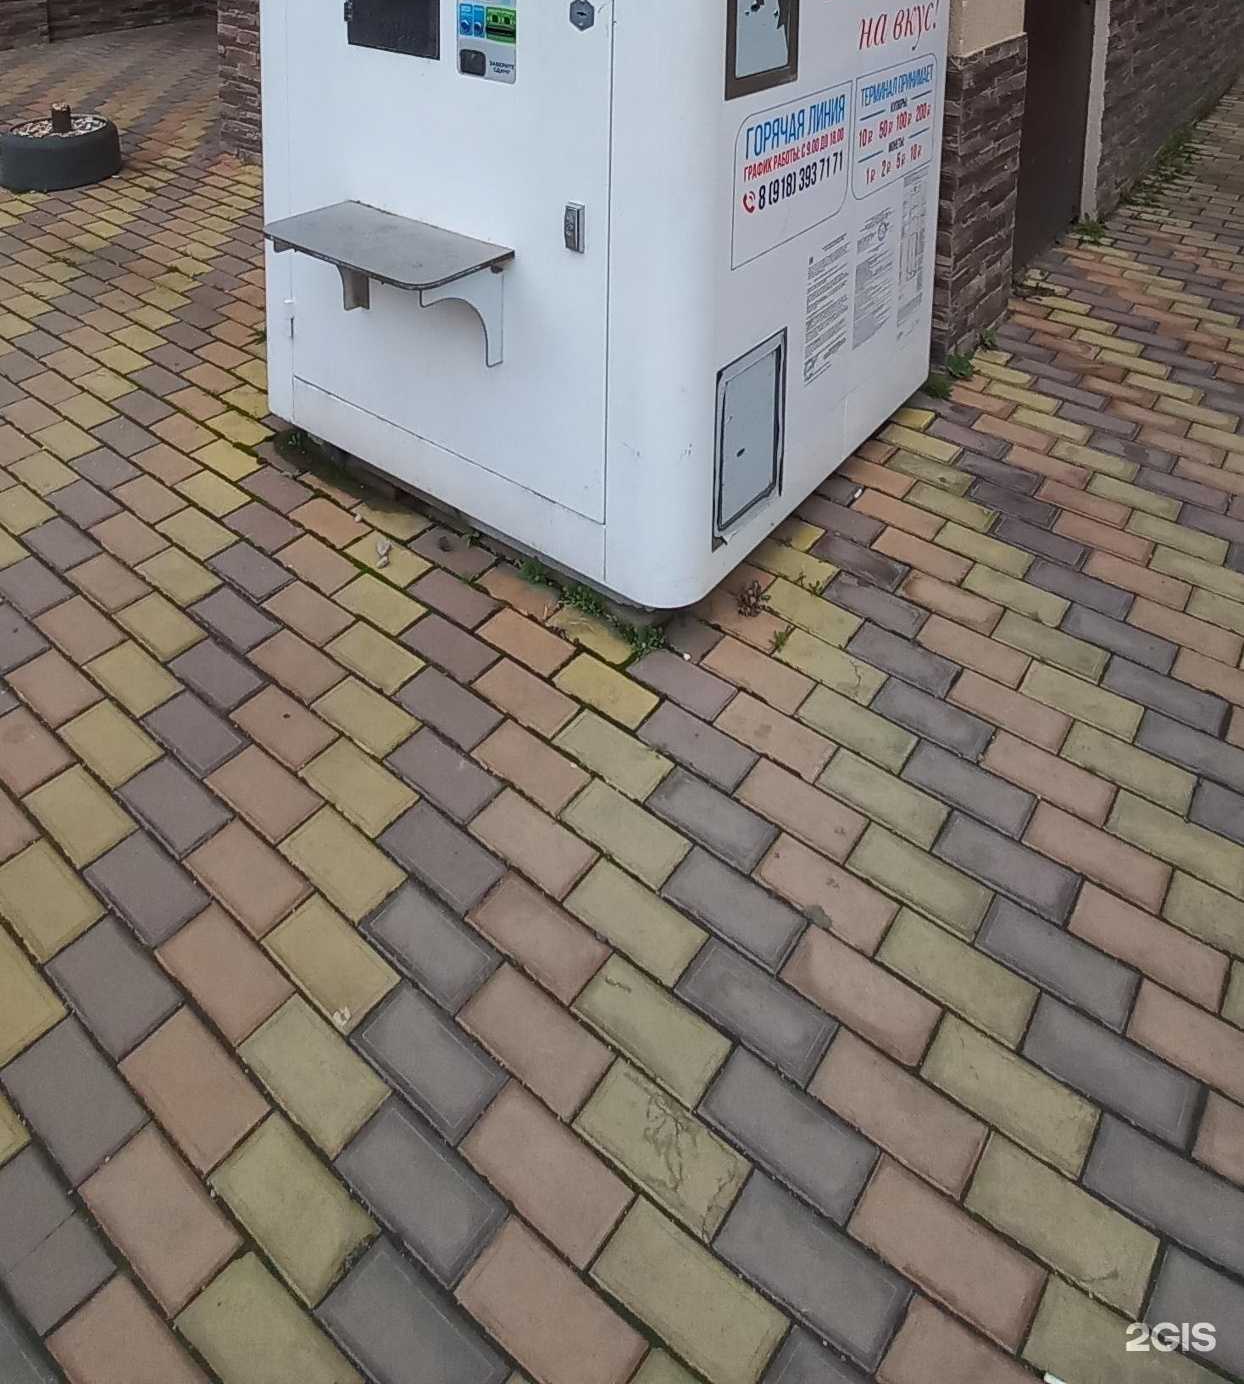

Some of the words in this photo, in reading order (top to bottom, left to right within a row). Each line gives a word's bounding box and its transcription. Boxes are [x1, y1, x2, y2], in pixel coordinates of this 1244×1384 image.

[859, 15, 886, 50] на
[861, 76, 897, 108] ТЕРМИНАЛ
[898, 63, 934, 94] ПРИНИМАЕТ
[745, 109, 805, 160] ГОРЯЧАЯ
[808, 94, 845, 135] ЛИНИЯ
[743, 157, 772, 182] ГРАФИК
[802, 143, 806, 158] С
[758, 185, 766, 210] 8
[768, 171, 797, 206] (918)
[799, 162, 818, 191] 393
[820, 156, 830, 181] 71
[833, 149, 843, 175] 71
